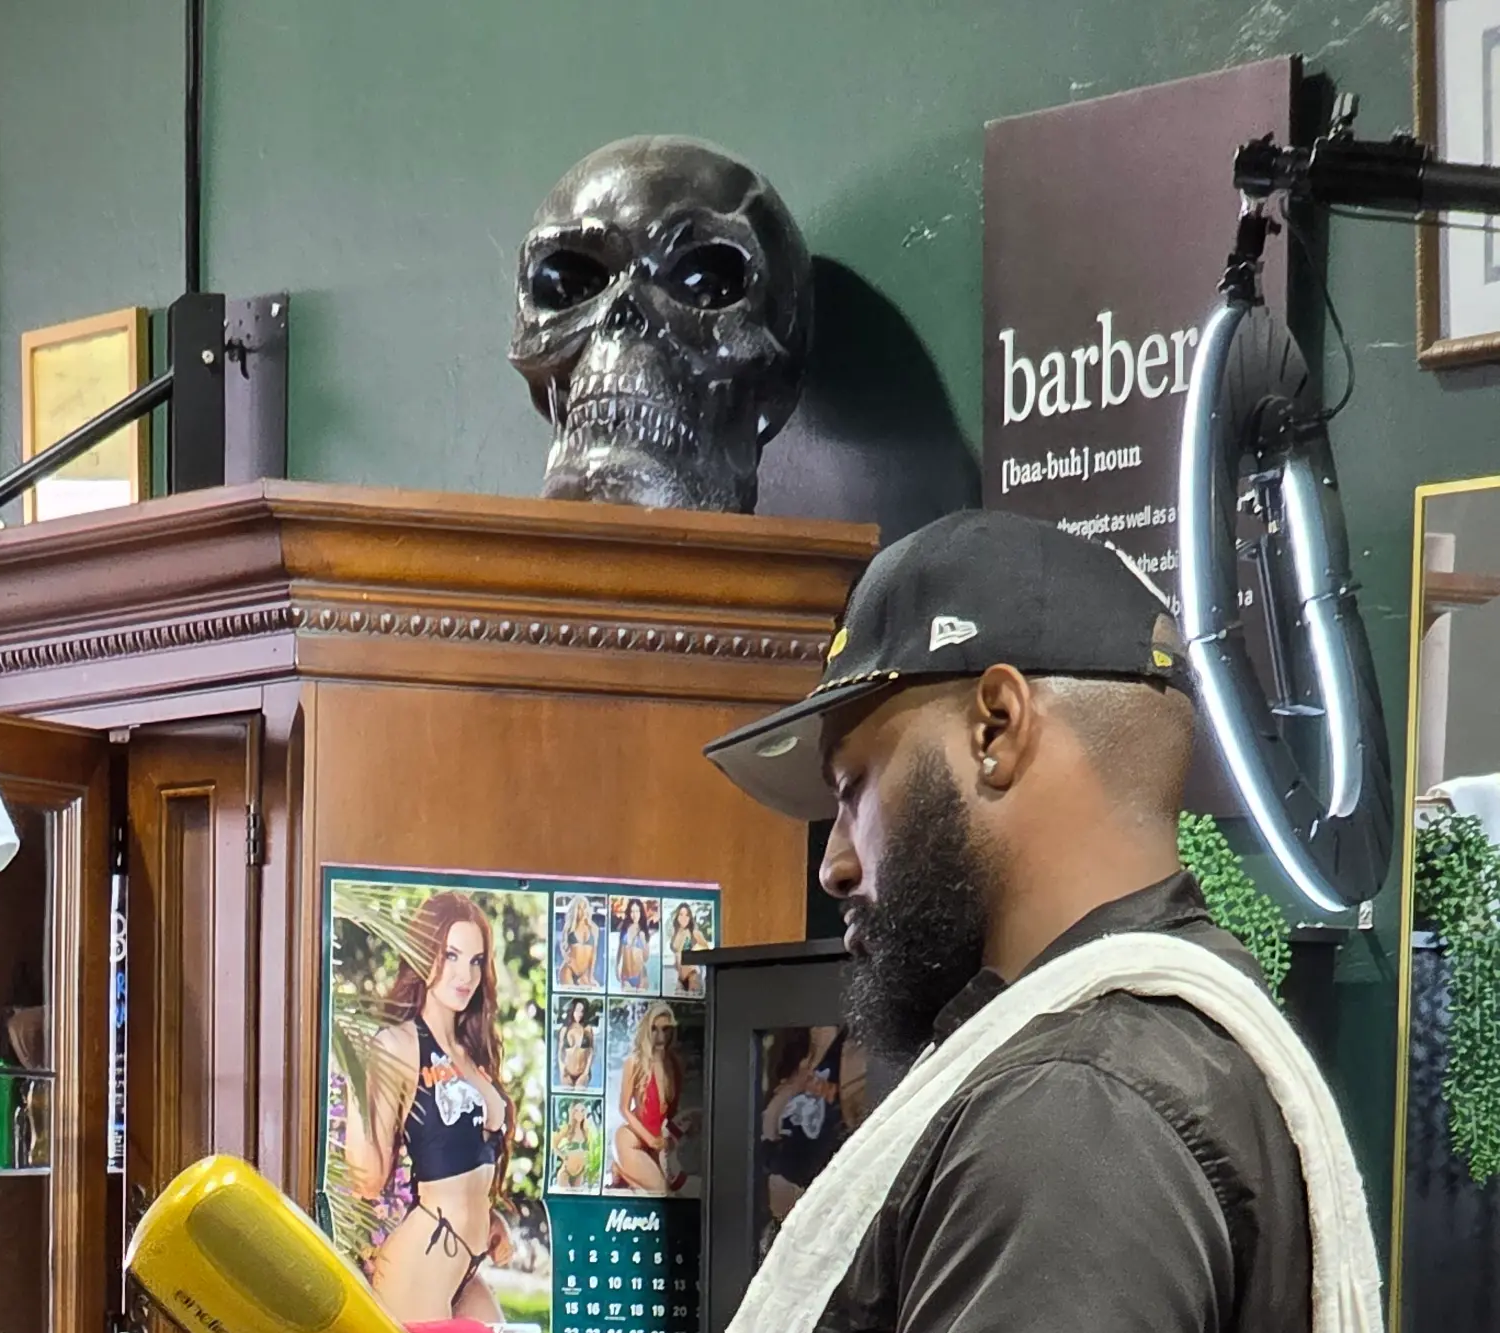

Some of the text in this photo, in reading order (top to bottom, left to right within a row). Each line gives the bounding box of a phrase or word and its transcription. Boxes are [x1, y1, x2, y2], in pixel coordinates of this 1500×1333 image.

[999, 311, 1199, 425] barber
[1093, 445, 1142, 474] noun
[1111, 513, 1126, 531] as
[1126, 504, 1151, 529] well
[1153, 508, 1166, 525] as
[604, 1207, 661, 1233] March
[568, 1249, 575, 1262] 1
[589, 1249, 598, 1263] 2
[610, 1250, 619, 1263] 3
[632, 1251, 641, 1264] 4
[654, 1252, 663, 1265] 5
[589, 1275, 598, 1289] 9
[608, 1276, 622, 1290] 10
[631, 1277, 642, 1290] 11
[652, 1278, 665, 1291] 12
[674, 1279, 686, 1291] 13
[565, 1302, 579, 1315] 15
[586, 1302, 600, 1315] 16
[609, 1303, 622, 1316] 17
[630, 1304, 644, 1316] 18
[652, 1304, 665, 1317] 19
[673, 1305, 687, 1317] 20
